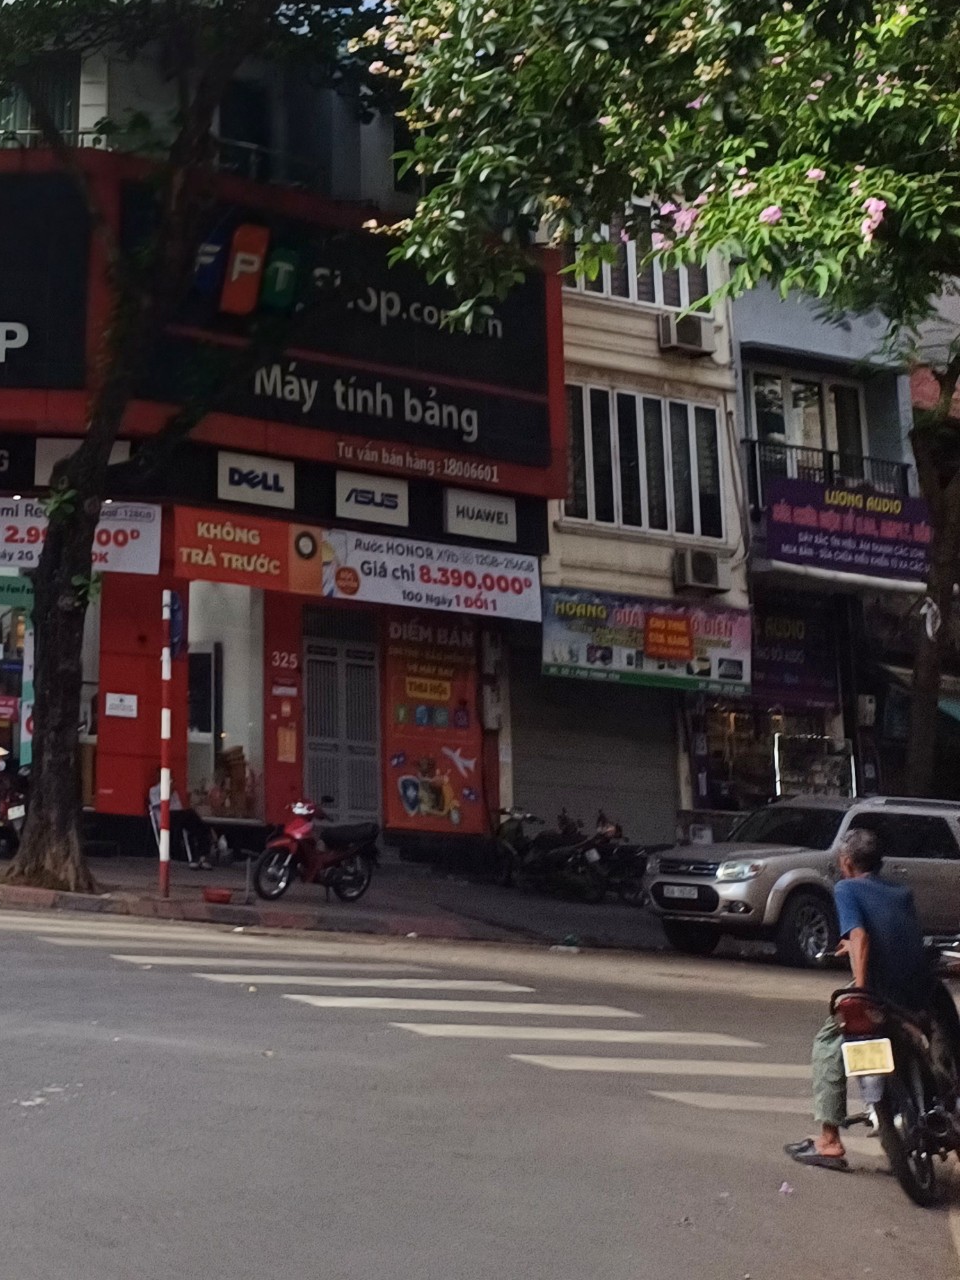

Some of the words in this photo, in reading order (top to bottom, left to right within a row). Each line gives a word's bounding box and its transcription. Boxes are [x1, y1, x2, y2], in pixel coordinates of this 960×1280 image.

[253, 361, 319, 414] Máy
[333, 375, 394, 420] tính
[404, 386, 479, 442] bảng
[382, 447, 404, 468] bán
[406, 451, 436, 476] hàng
[443, 457, 500, 483] 18006601
[228, 466, 285, 493] DELL
[345, 487, 399, 510] ASUS
[866, 495, 903, 515] AUDIO
[455, 504, 509, 525] HUAWEI
[196, 521, 261, 545] KHÔNG
[179, 544, 217, 567] TRẢ
[219, 552, 281, 575] TRƯỚC
[386, 542, 434, 561] HONOR
[360, 560, 388, 579] Giá
[392, 563, 416, 582] chỉ
[401, 589, 423, 603] 100
[271, 650, 298, 670] 325
